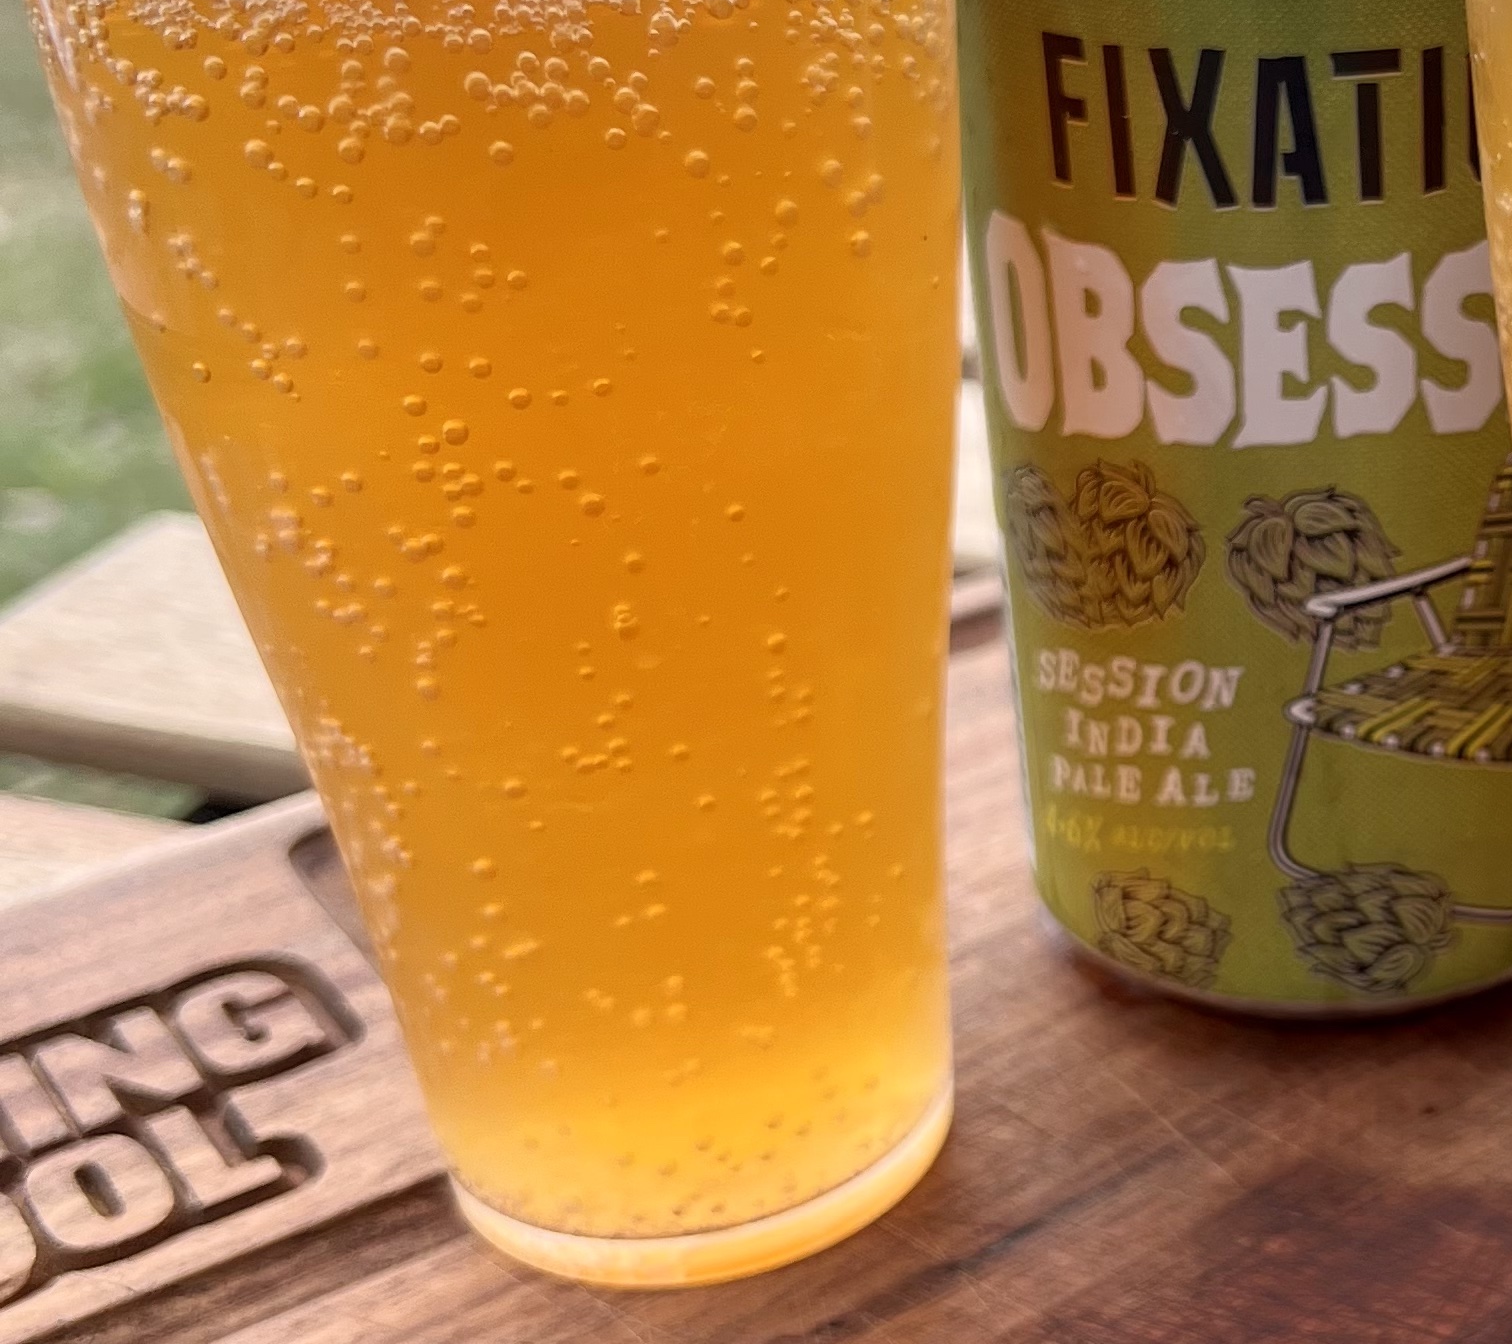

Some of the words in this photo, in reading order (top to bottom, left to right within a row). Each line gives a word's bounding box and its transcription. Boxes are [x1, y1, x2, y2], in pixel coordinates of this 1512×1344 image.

[1041, 31, 1482, 211] FIXATI
[984, 207, 1502, 449] OBSESS
[1038, 647, 1245, 712] SESSION
[1065, 707, 1212, 760] INDIA
[1052, 753, 1143, 805] PALE
[1156, 766, 1256, 808] ALE
[0, 969, 328, 1148] ING
